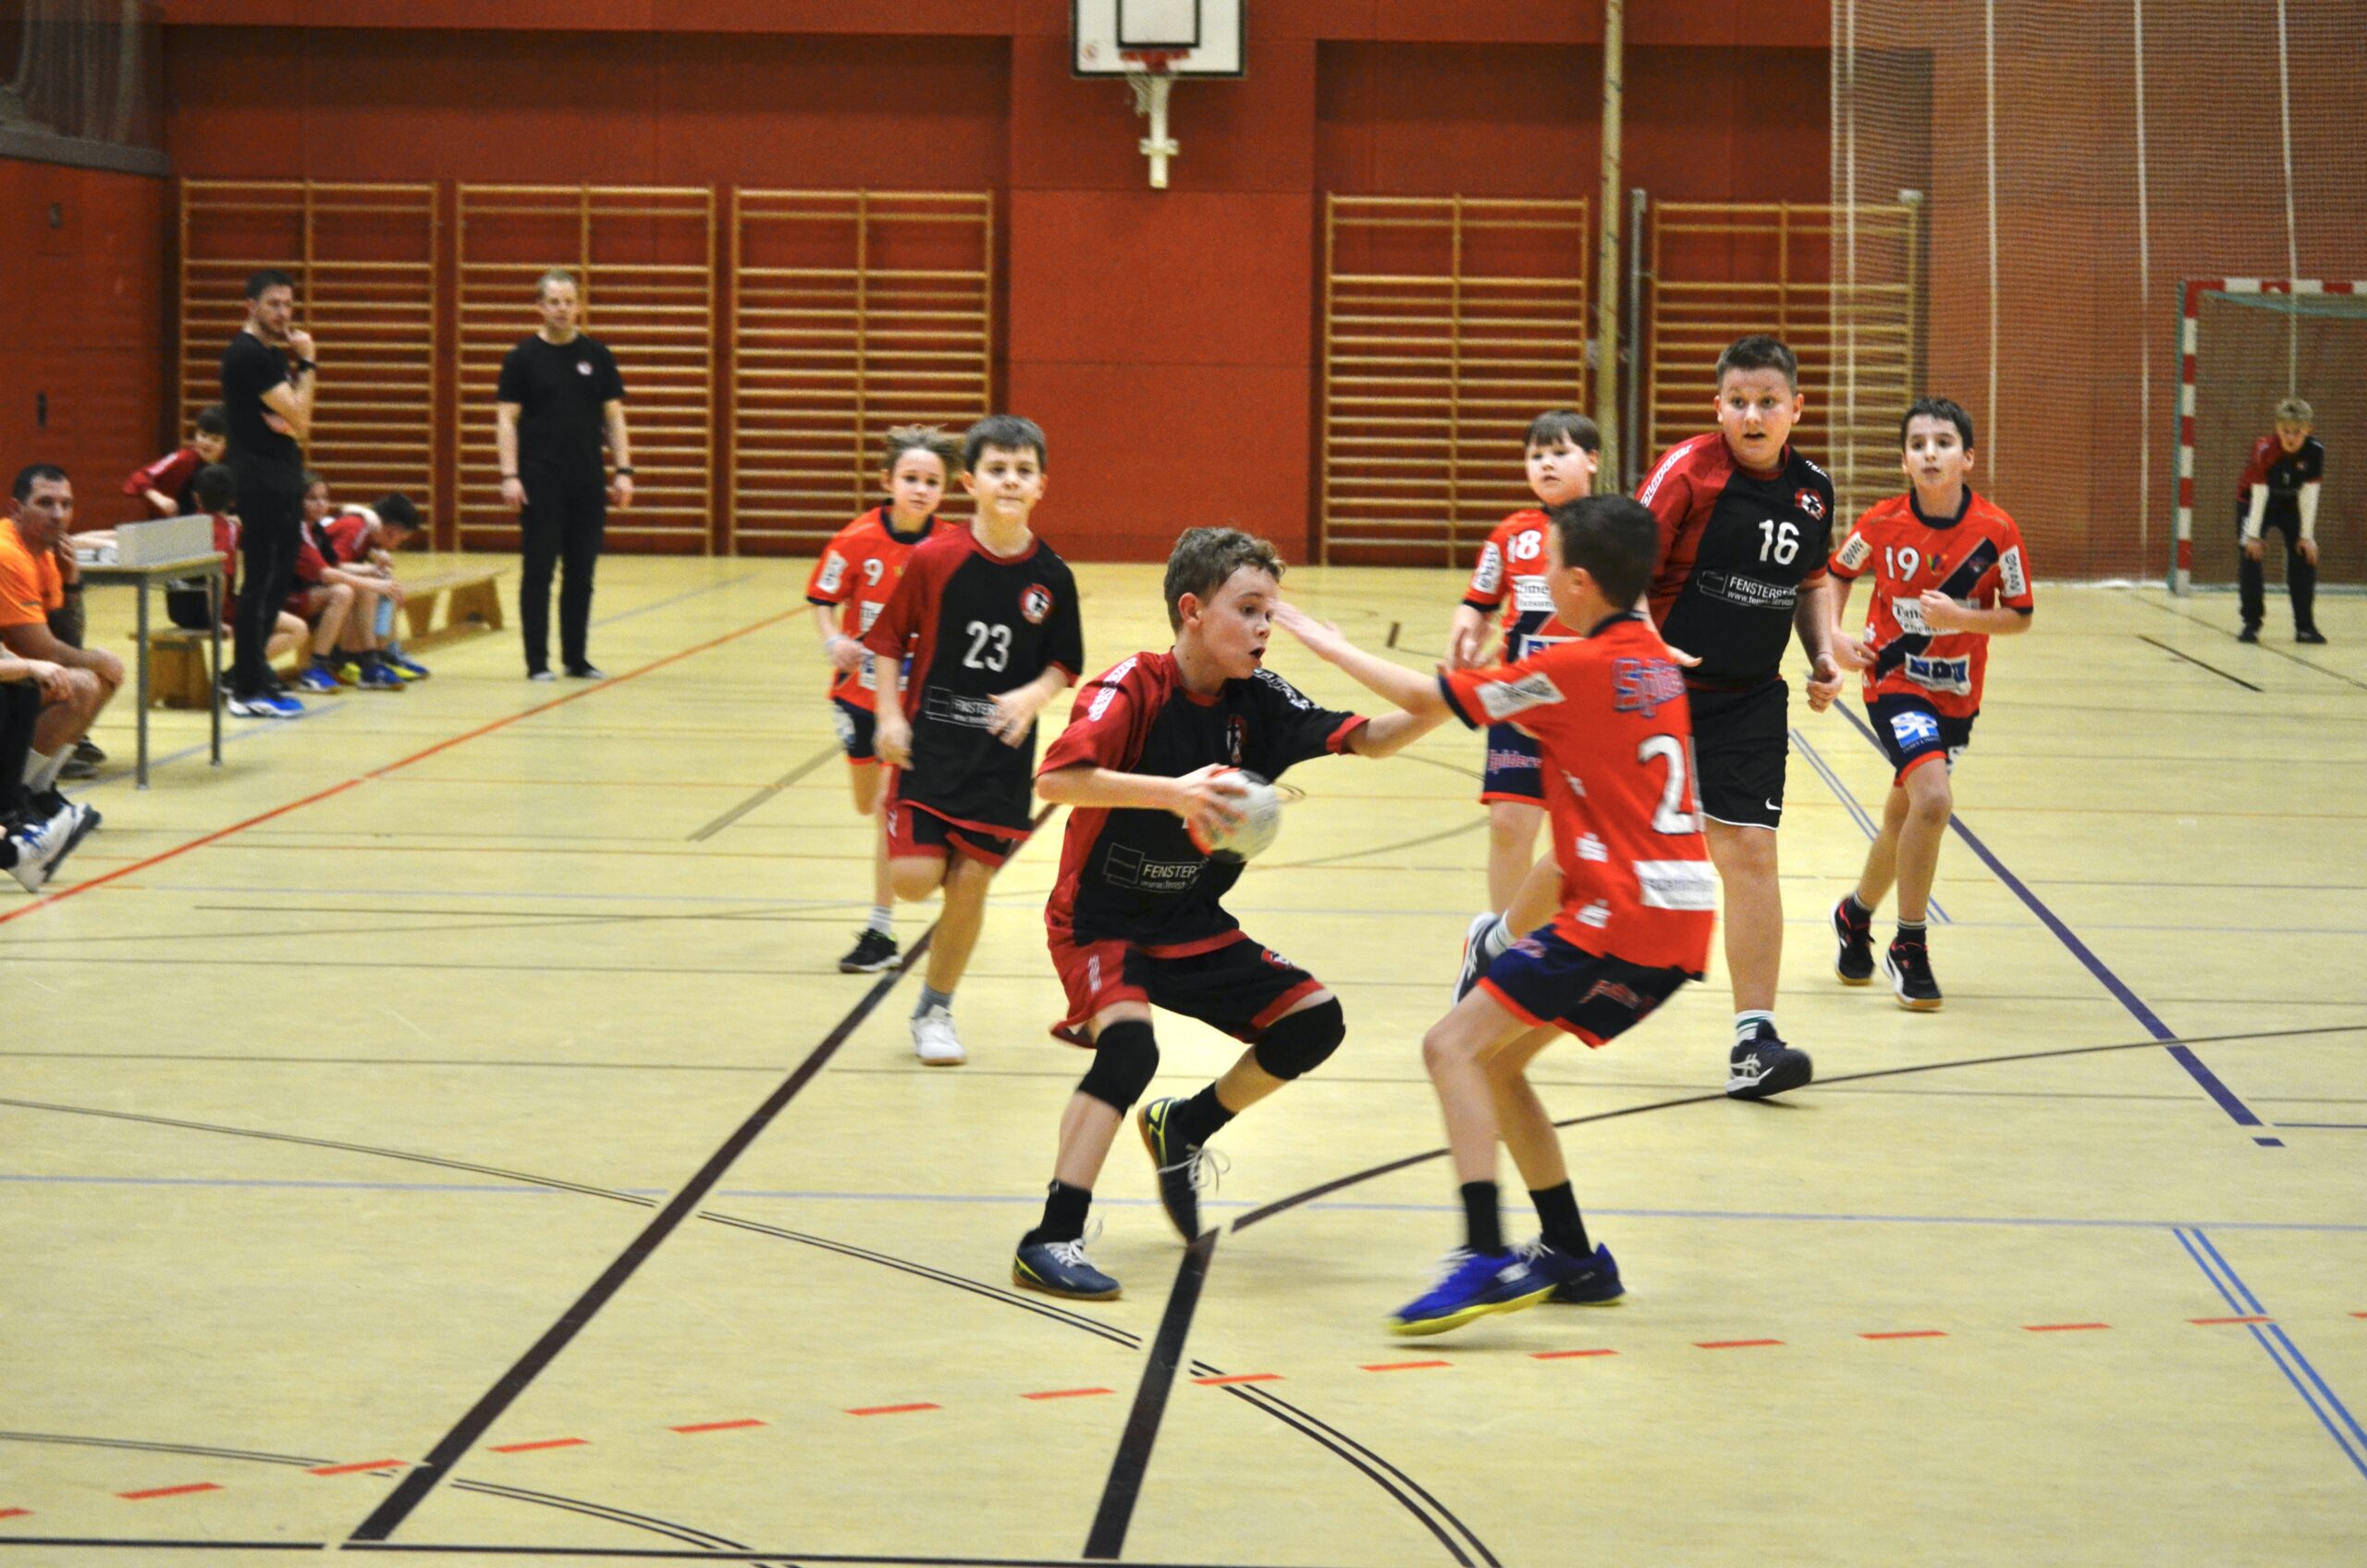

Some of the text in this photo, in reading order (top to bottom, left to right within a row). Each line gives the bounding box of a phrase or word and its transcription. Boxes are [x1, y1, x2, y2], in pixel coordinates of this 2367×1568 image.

[1507, 530, 1542, 563] 18
[1759, 519, 1800, 566] 16
[1884, 545, 1920, 582] 19
[863, 558, 885, 587] 9
[963, 620, 1012, 673] 23
[1637, 733, 1705, 835] 2
